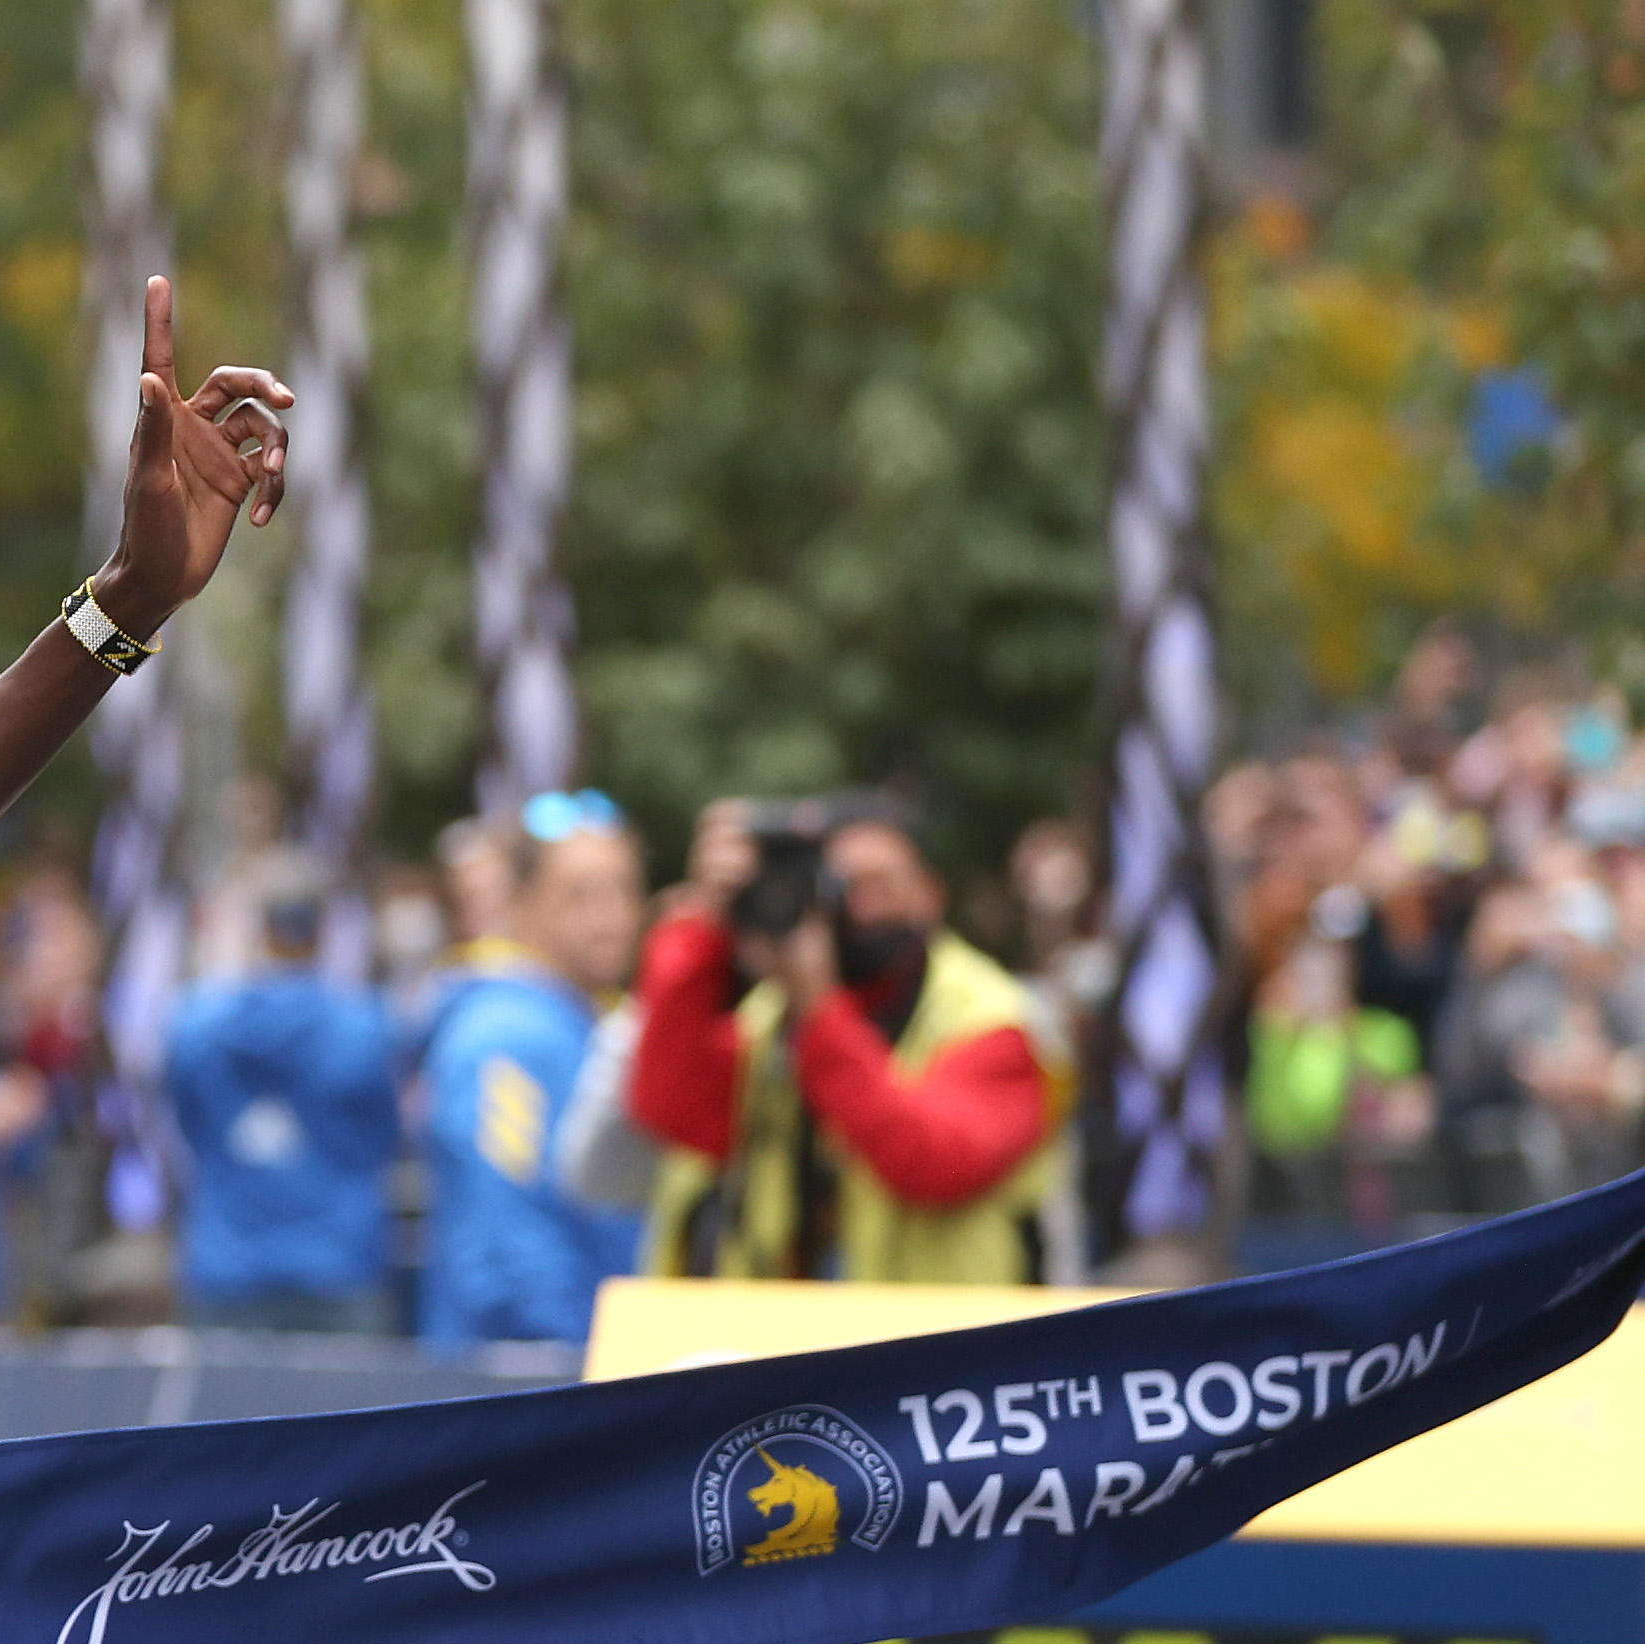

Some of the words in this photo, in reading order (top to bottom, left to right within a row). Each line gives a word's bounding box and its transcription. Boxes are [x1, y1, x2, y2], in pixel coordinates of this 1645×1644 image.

[898, 1374, 1104, 1465] 125TH
[1121, 1319, 1448, 1443] BOSTON
[209, 1480, 497, 1591] Hancock
[700, 1470, 725, 1564] BOSTON
[715, 1411, 811, 1472] ATHLETIC
[811, 1415, 896, 1541] ASSOCIATION
